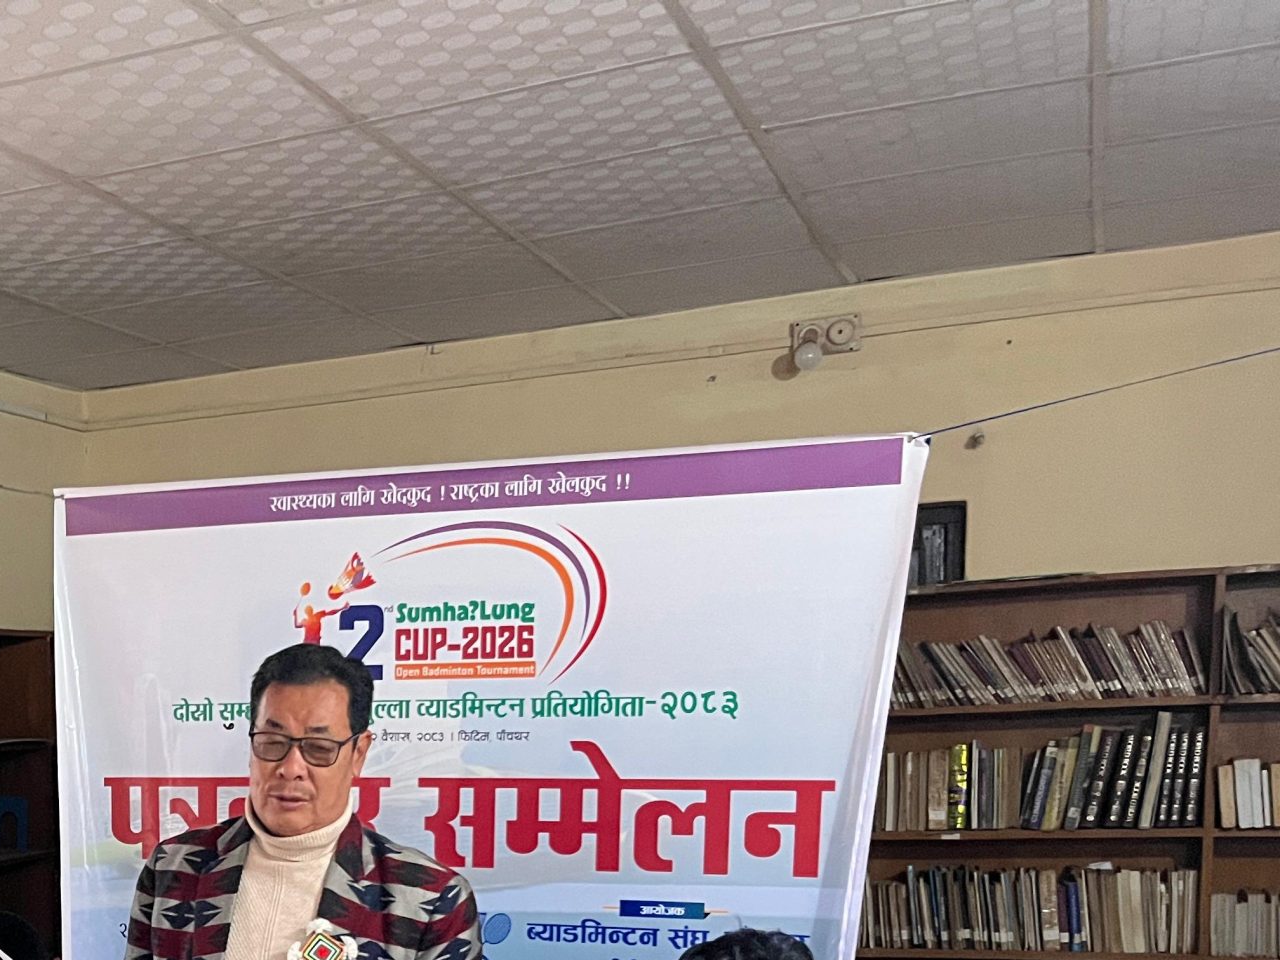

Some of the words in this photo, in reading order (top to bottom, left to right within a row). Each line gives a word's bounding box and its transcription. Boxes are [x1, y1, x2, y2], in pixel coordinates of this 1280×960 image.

[340, 485, 375, 507] लागि
[504, 474, 543, 497] लागि
[547, 471, 608, 497] खेलकुद
[395, 600, 535, 623] Sumha?Lung
[395, 625, 535, 661] CUP-2026
[396, 667, 420, 679] Open
[423, 665, 474, 677] Badminton
[477, 664, 535, 676] Tournament
[418, 741, 836, 878] सम्मेलन
[526, 919, 660, 947] ब्याडमिन्टन
